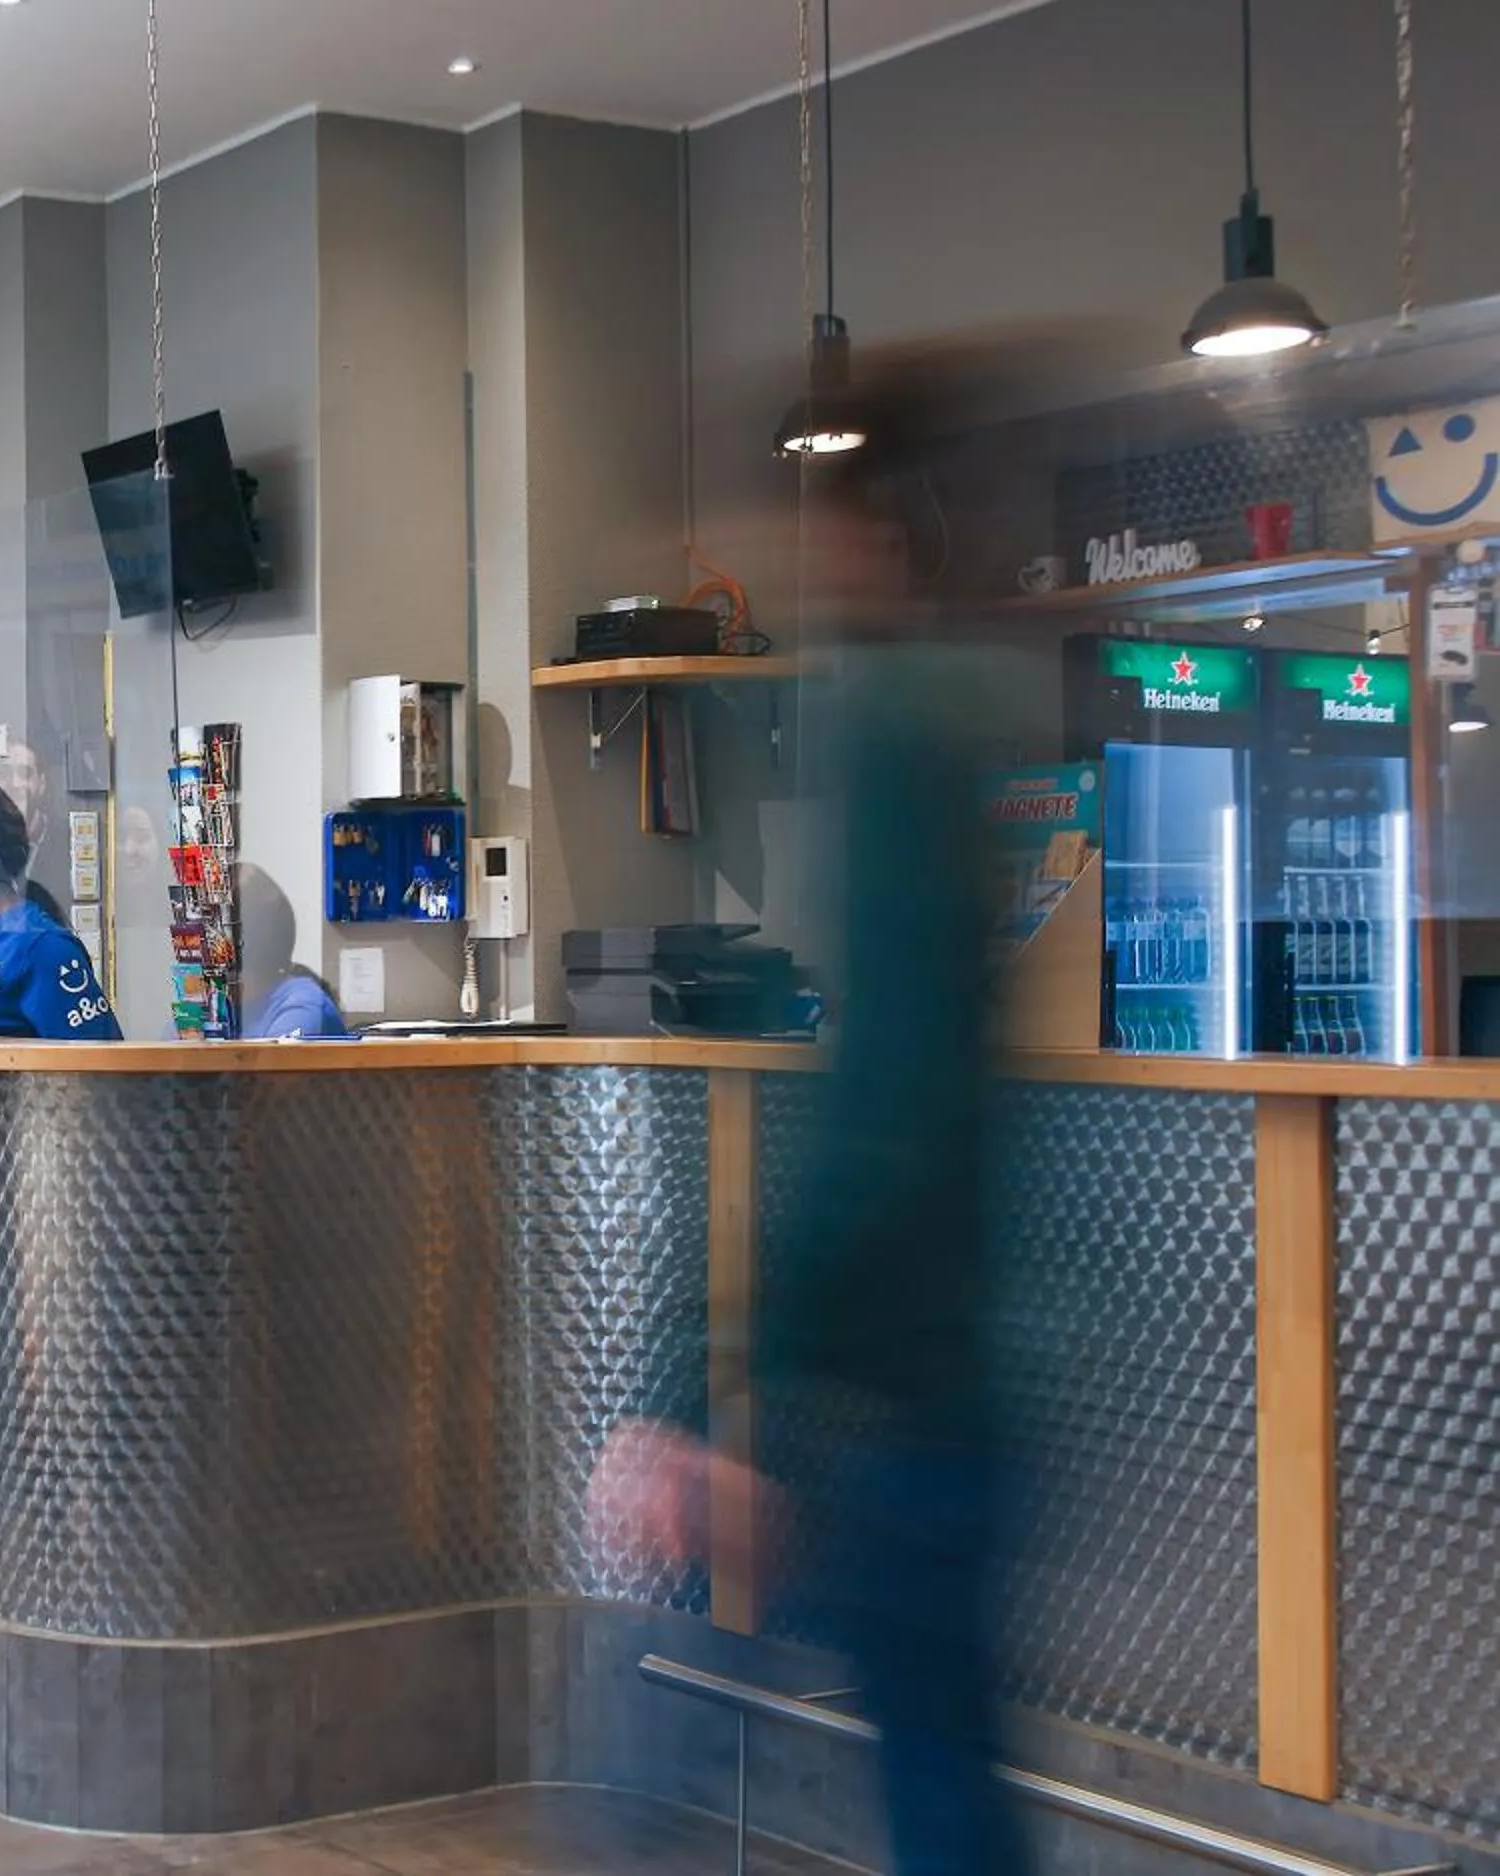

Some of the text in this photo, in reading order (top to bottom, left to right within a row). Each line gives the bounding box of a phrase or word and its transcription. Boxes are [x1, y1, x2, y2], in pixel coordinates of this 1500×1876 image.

[1085, 528, 1202, 586] Welcome
[1143, 688, 1221, 713] Heineken
[1323, 699, 1396, 723] Heineken
[67, 995, 109, 1027] a&o
